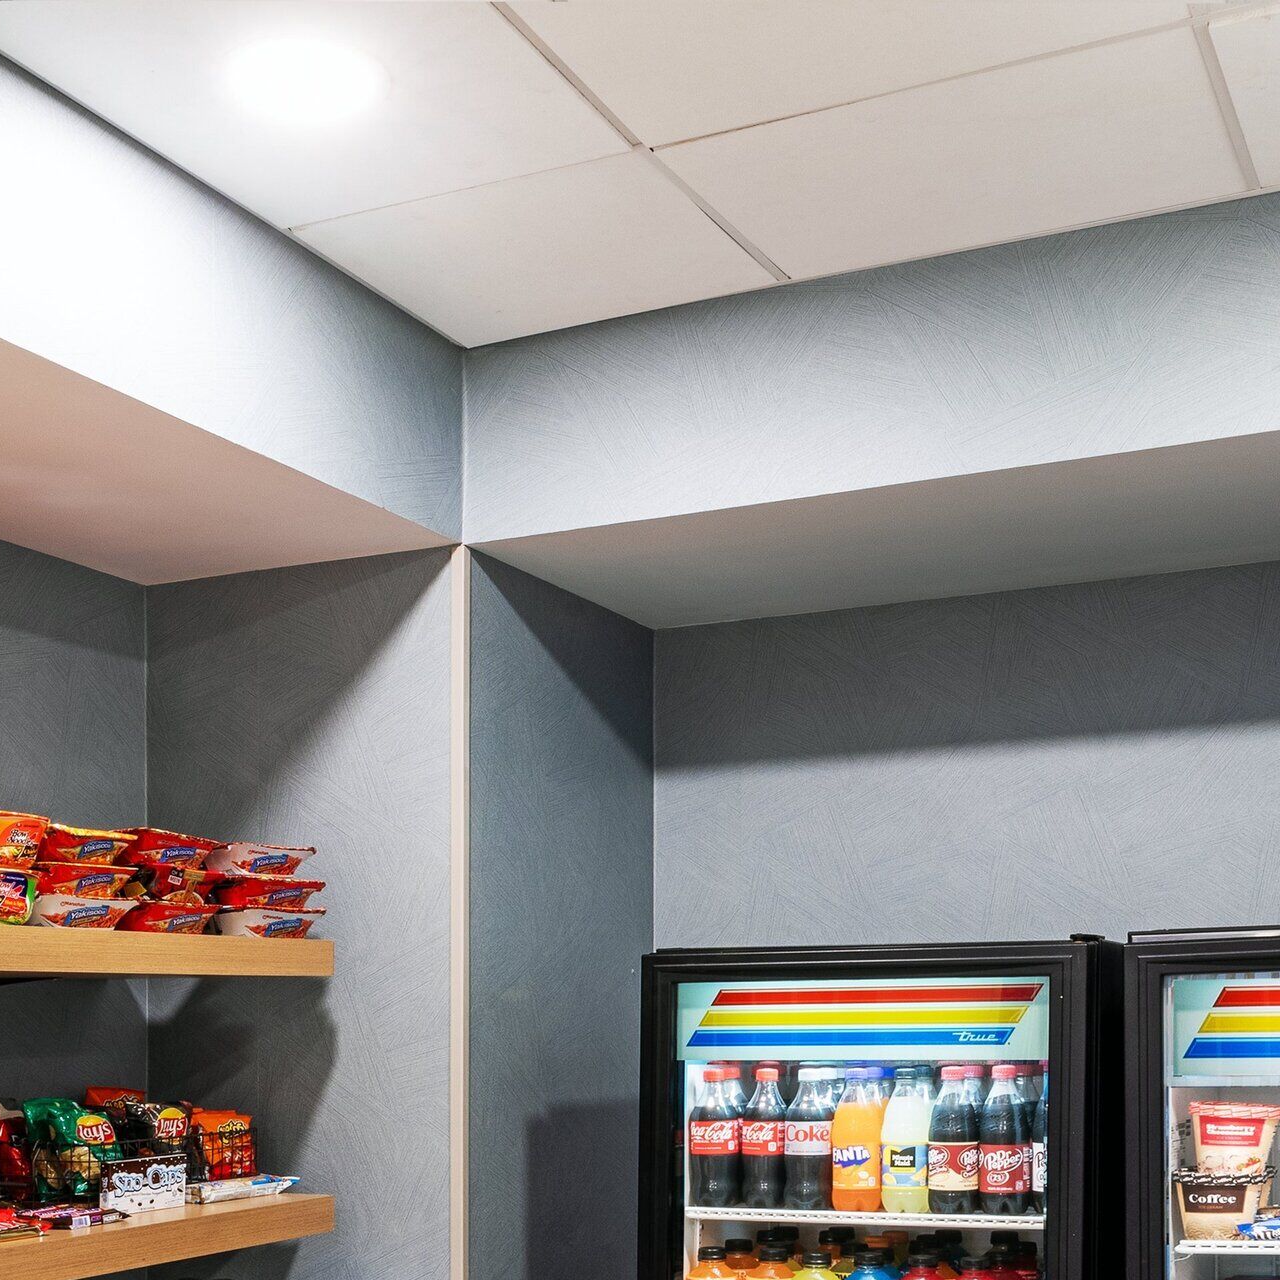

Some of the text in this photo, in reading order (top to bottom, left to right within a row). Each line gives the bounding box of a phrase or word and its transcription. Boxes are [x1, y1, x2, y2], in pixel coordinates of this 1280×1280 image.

[83, 842, 112, 854] Yakisoba
[166, 849, 195, 858] Yakisoba
[255, 857, 286, 867] Yakisoba
[81, 876, 112, 888] Yakisoba
[272, 890, 301, 900] Yakisoba
[70, 909, 107, 920] Yakisoba
[270, 921, 301, 932] Yakisoba
[78, 1122, 113, 1142] Lay's
[156, 1117, 185, 1138] Lay's
[786, 1124, 830, 1142] Coke
[996, 1150, 1012, 1160] Dr
[986, 1154, 1021, 1171] Pepper
[1188, 1194, 1236, 1204] Coffee
